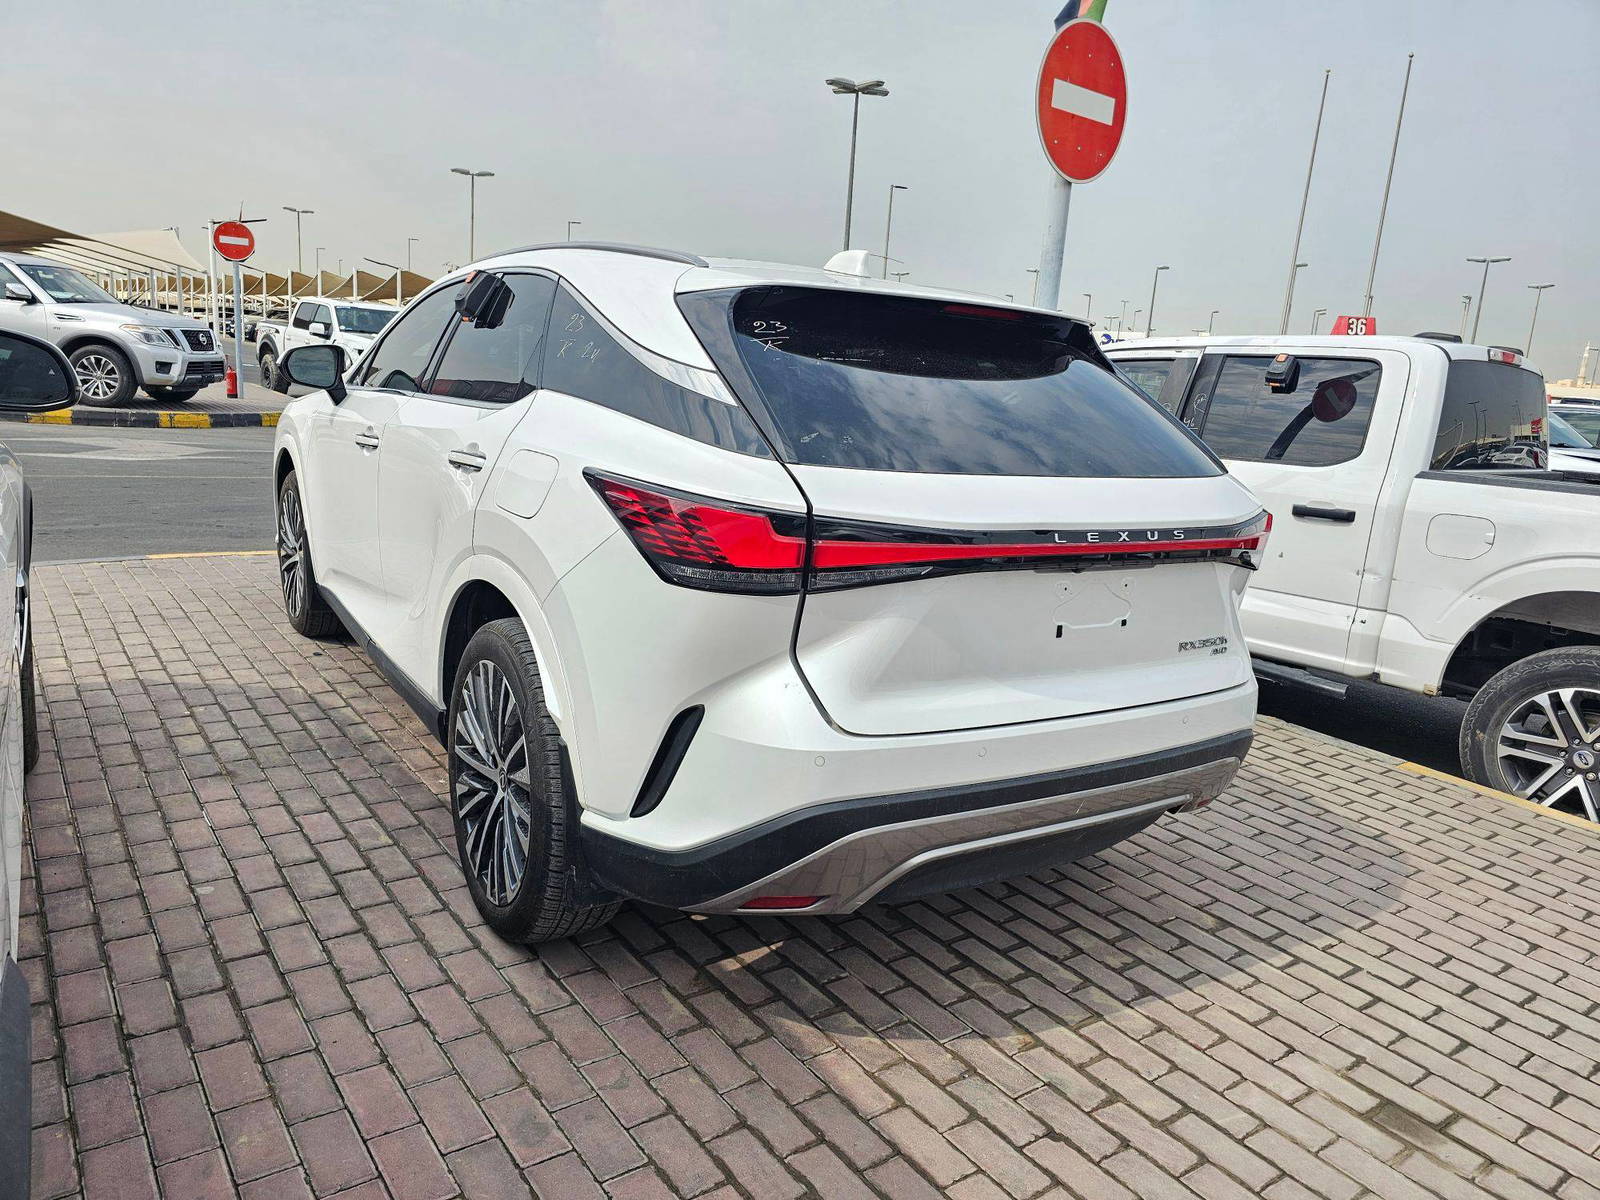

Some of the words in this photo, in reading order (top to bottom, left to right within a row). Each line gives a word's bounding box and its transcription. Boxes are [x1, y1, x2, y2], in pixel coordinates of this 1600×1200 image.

[565, 313, 585, 332] 23
[753, 320, 787, 333] 23
[1347, 318, 1367, 335] 36
[1054, 530, 1185, 543] LEXUS
